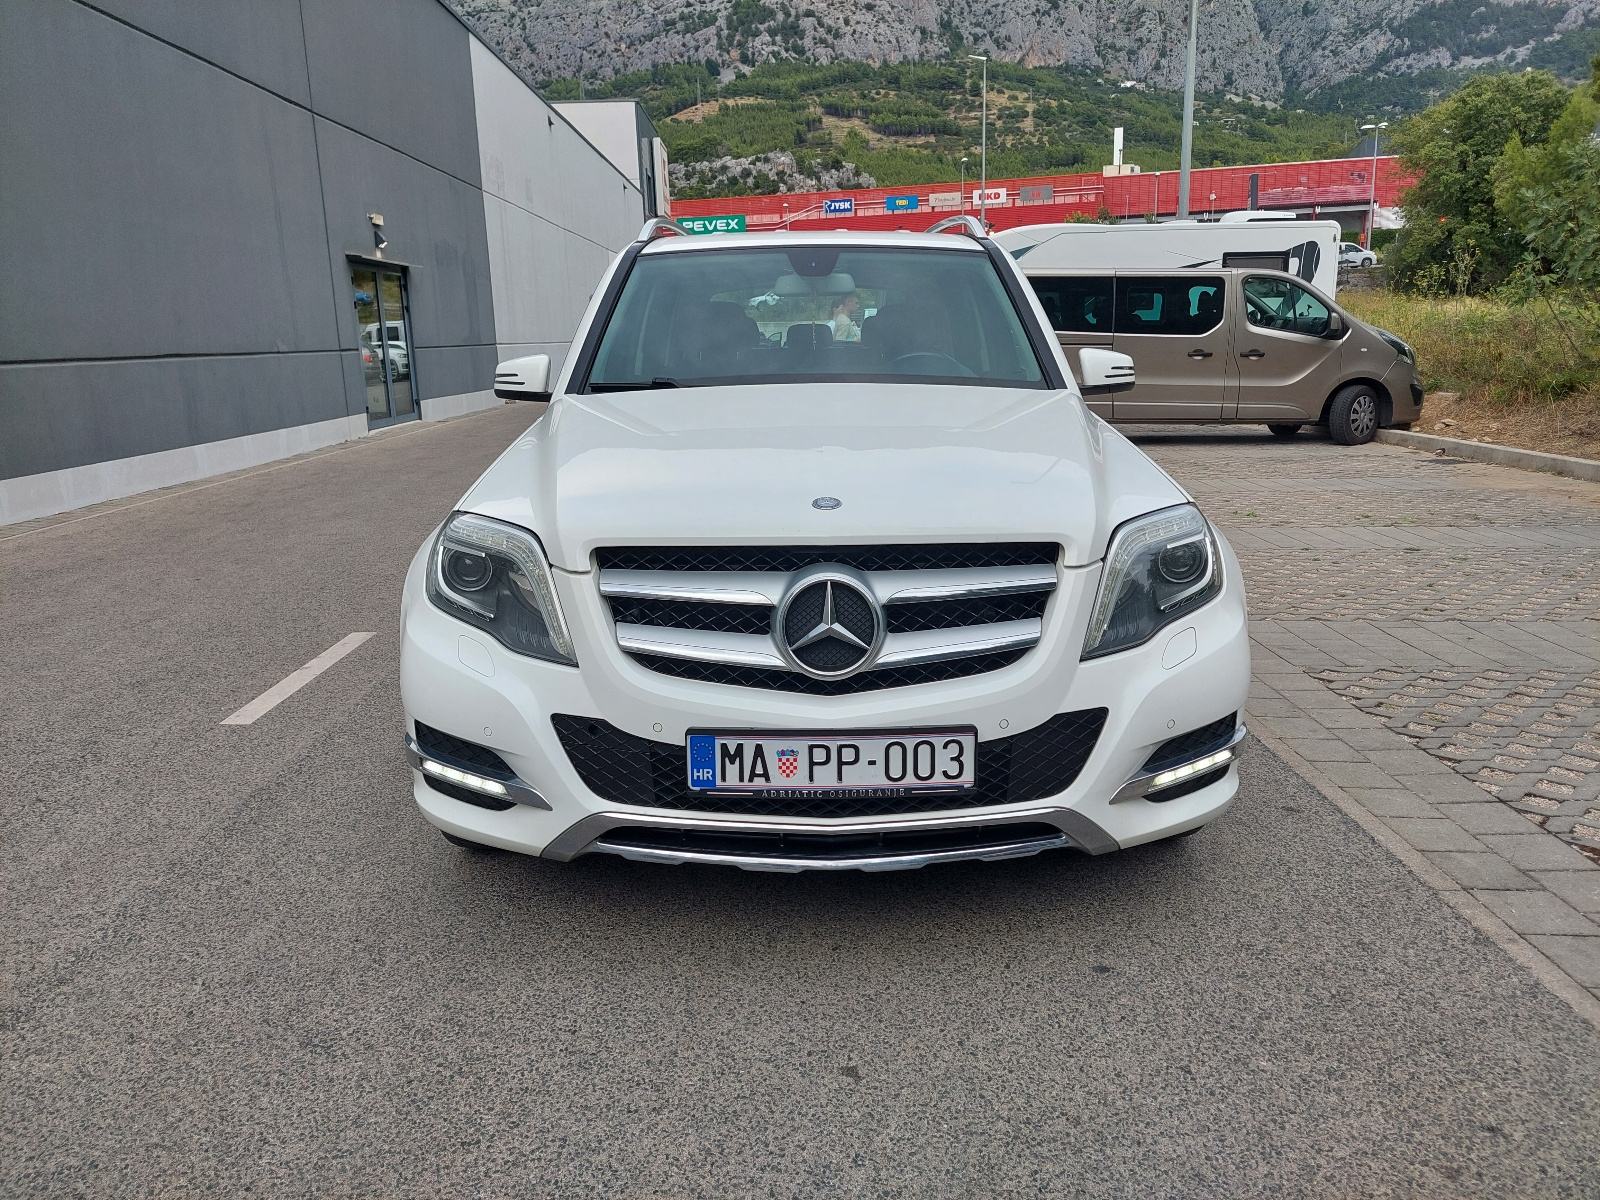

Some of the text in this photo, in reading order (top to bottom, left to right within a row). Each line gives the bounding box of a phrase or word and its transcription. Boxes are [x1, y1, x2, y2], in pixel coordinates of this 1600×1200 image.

[830, 201, 851, 210] JYSK
[682, 218, 739, 231] PEVEX
[720, 738, 964, 784] MA PP-003
[693, 768, 713, 781] HR
[761, 788, 905, 798] ADRIATIC OSIGURANJE
